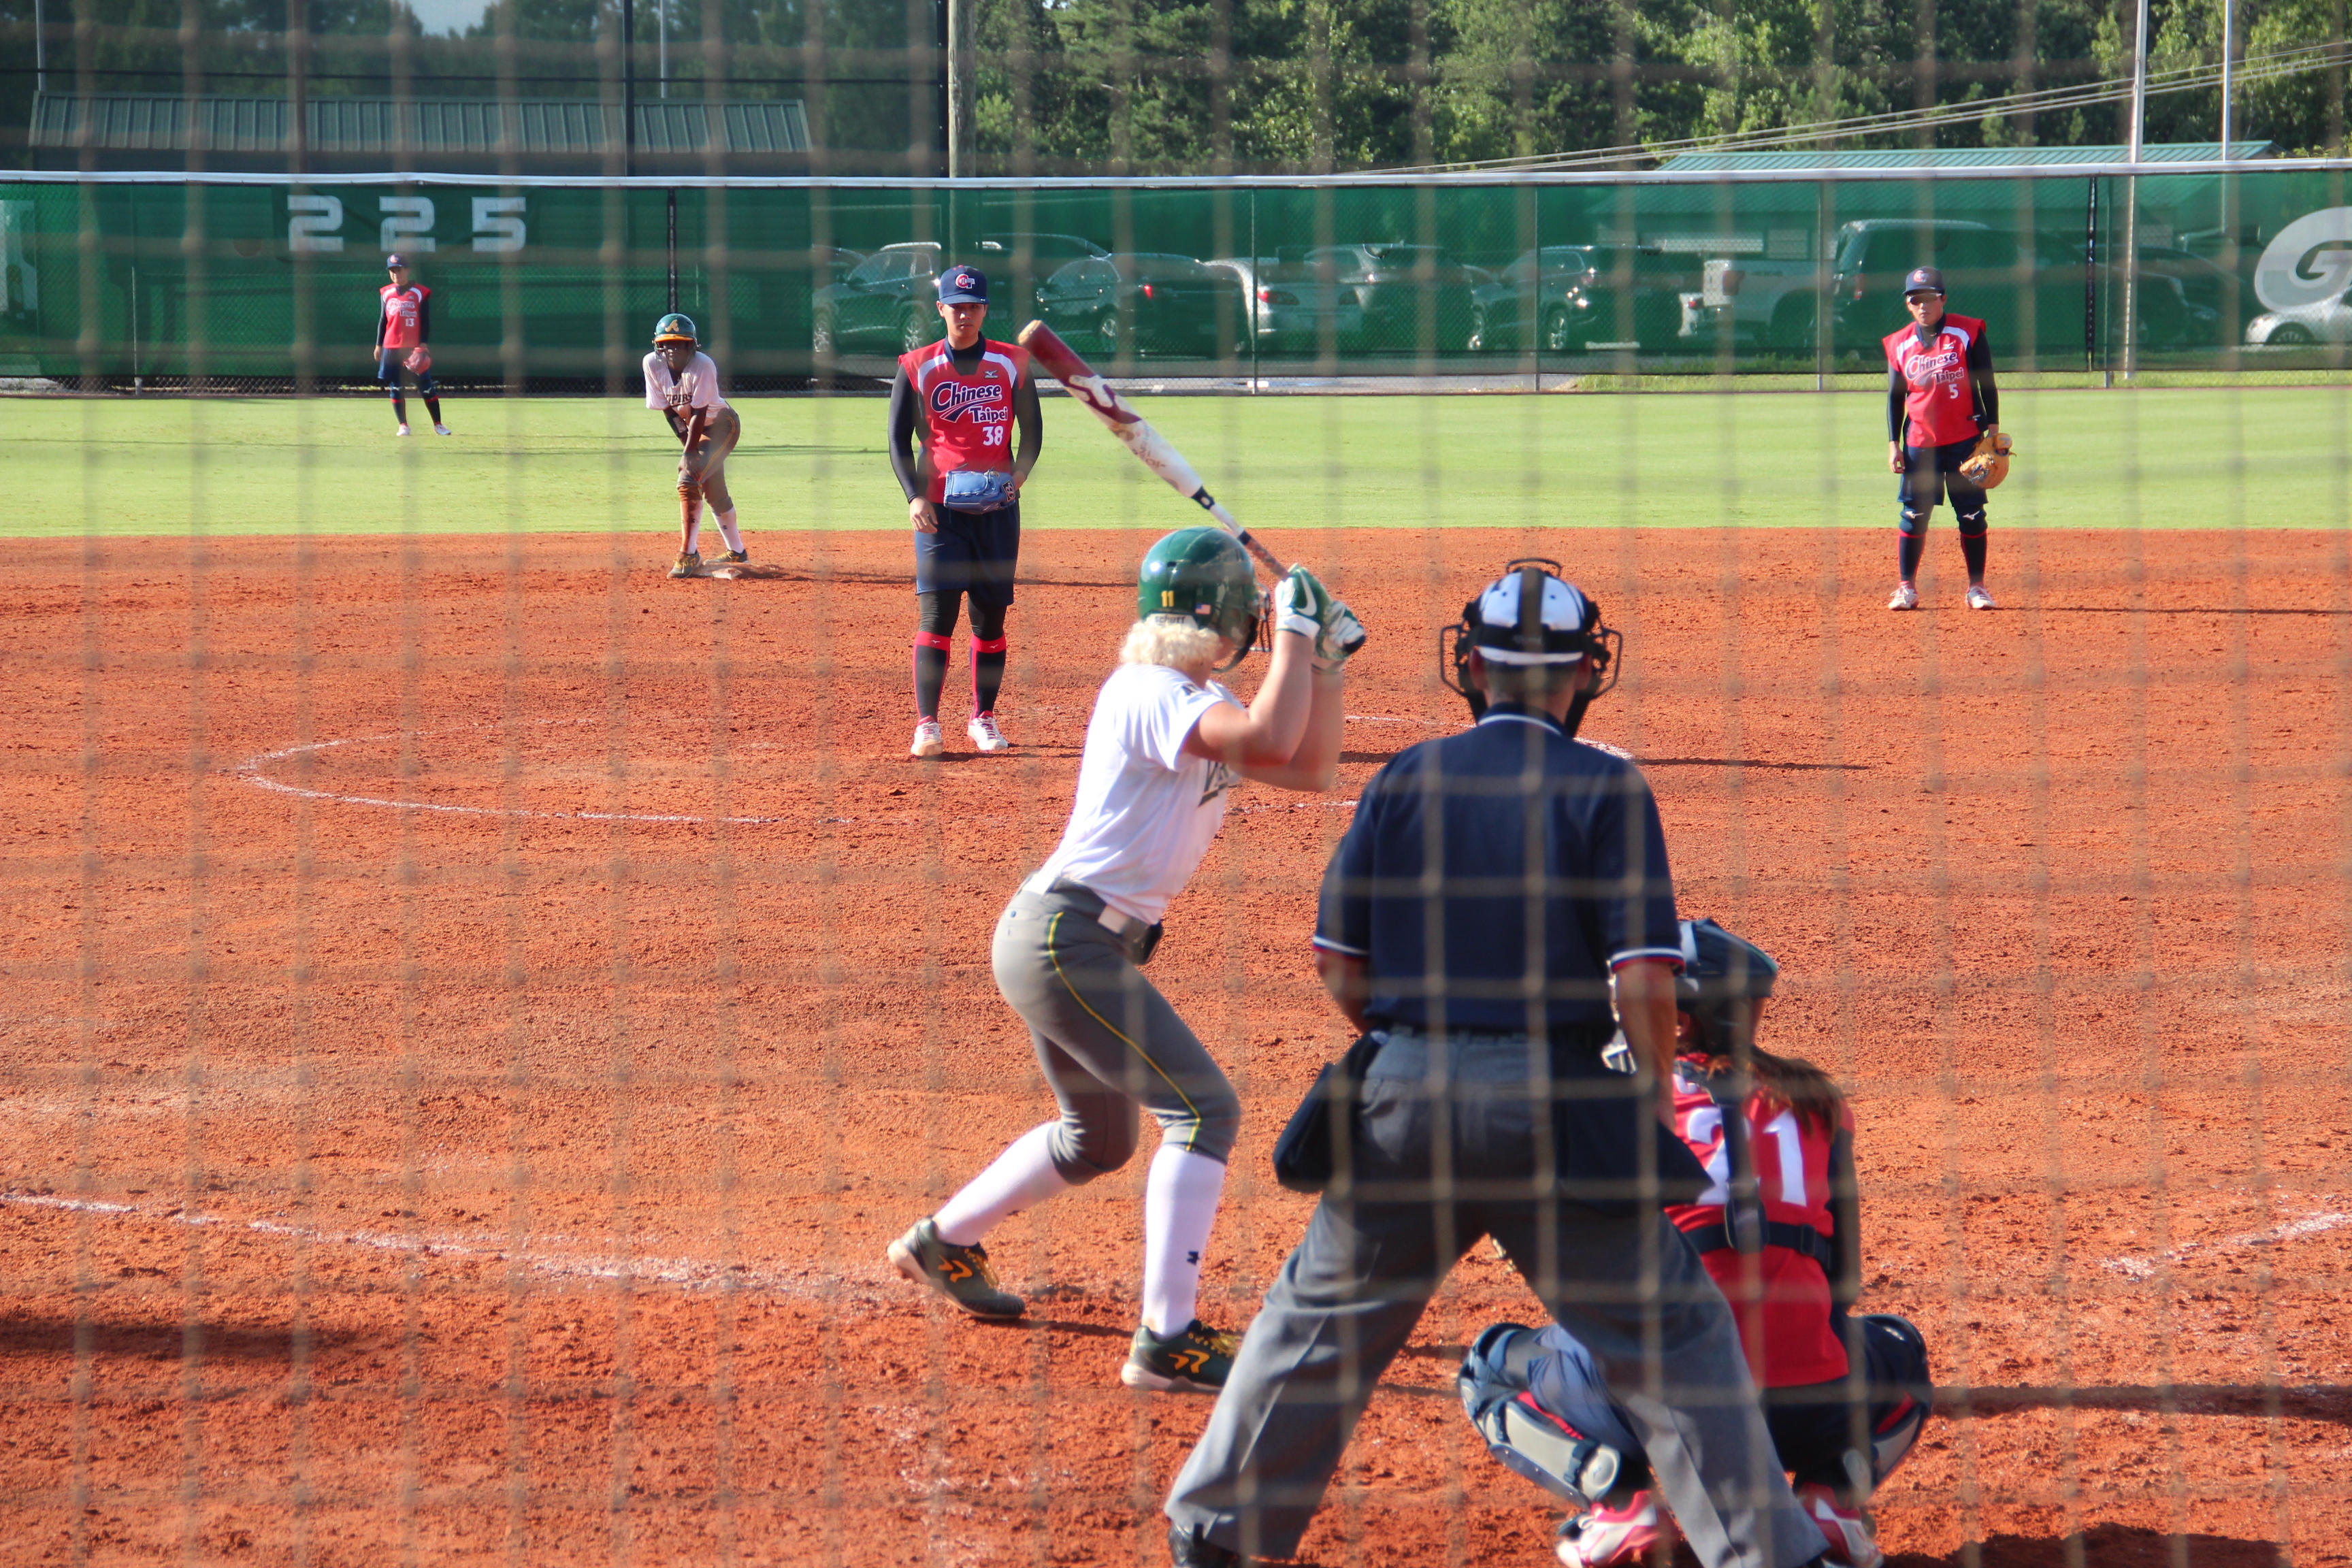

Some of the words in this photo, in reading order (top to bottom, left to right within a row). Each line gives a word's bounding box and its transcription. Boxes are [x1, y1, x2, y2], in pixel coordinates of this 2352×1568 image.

[406, 318, 414, 327] 13
[1905, 352, 1958, 380] Chinese
[1932, 367, 1964, 385] Taipei
[930, 381, 1002, 413] Chinese
[1948, 383, 1959, 399] 5
[968, 406, 1008, 423] Taipei
[982, 425, 1004, 446] 38
[1161, 590, 1174, 607] 11
